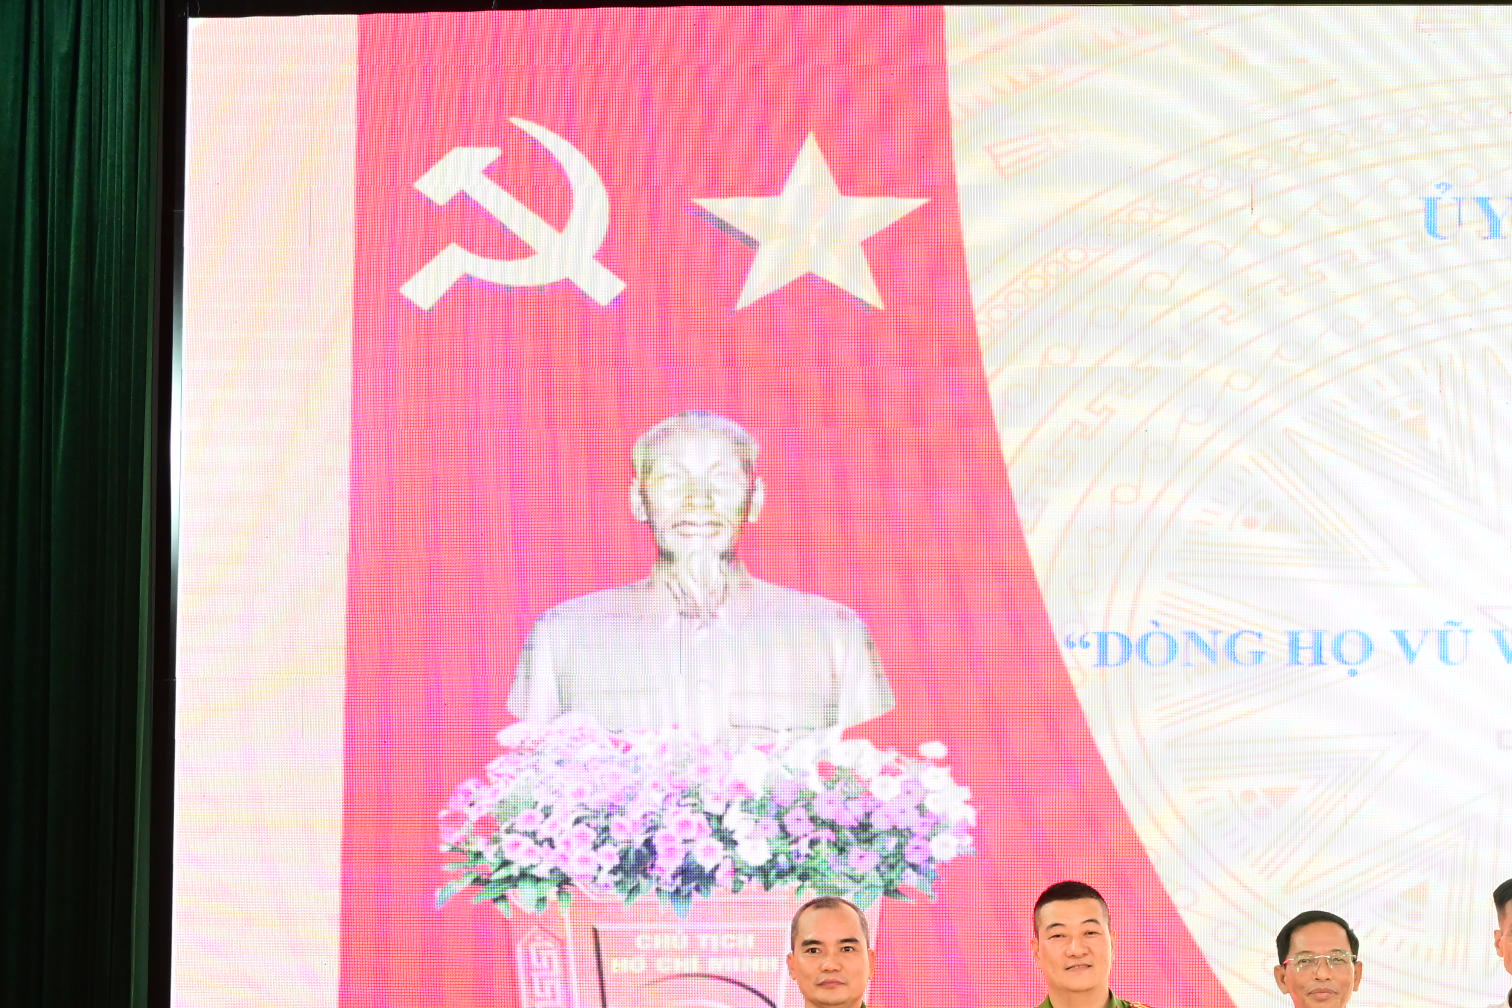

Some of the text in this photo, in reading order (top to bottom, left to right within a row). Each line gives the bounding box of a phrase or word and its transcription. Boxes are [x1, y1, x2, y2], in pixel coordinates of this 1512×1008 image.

[1063, 620, 1268, 668] “DÒNG
[1286, 628, 1376, 678] HỌ
[1390, 619, 1474, 666] VŨ
